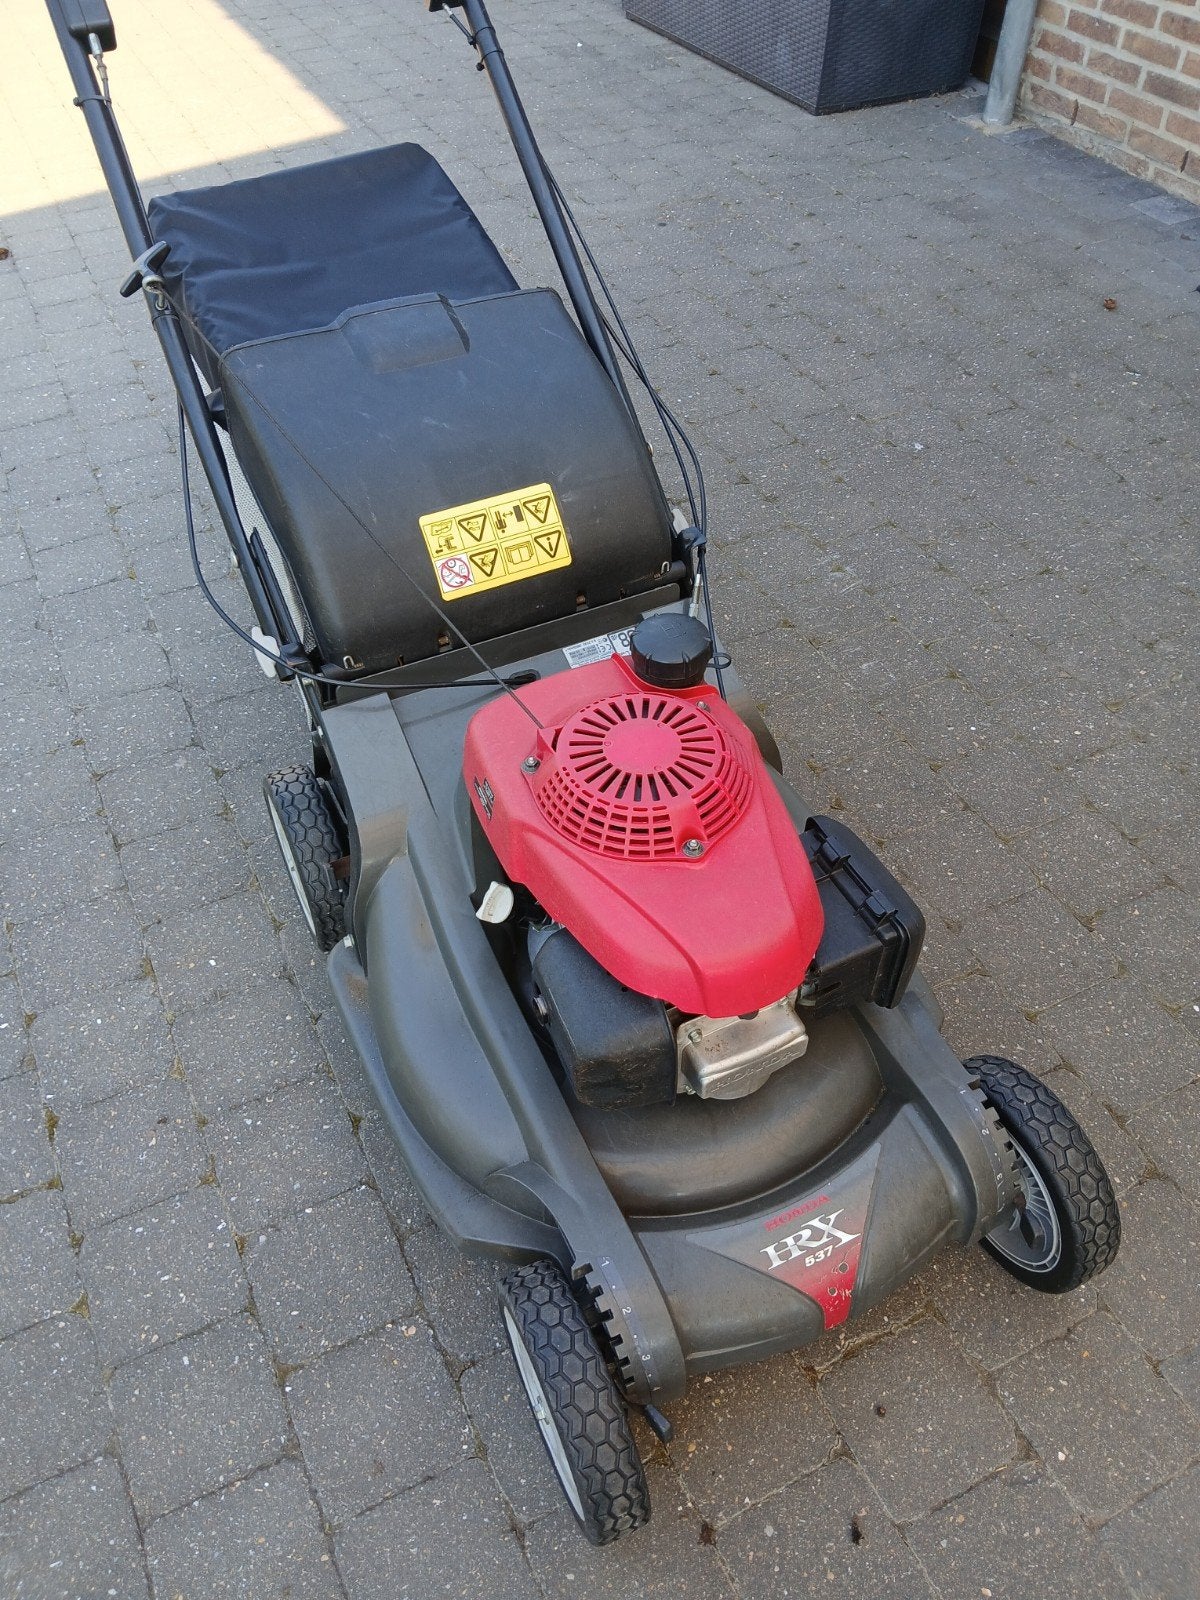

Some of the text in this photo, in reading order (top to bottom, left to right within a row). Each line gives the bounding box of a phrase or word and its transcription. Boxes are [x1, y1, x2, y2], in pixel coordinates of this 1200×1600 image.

[764, 1195, 831, 1232] HONDA
[760, 1208, 861, 1270] HRX
[805, 1245, 833, 1267] 537
[622, 1306, 632, 1316] 2
